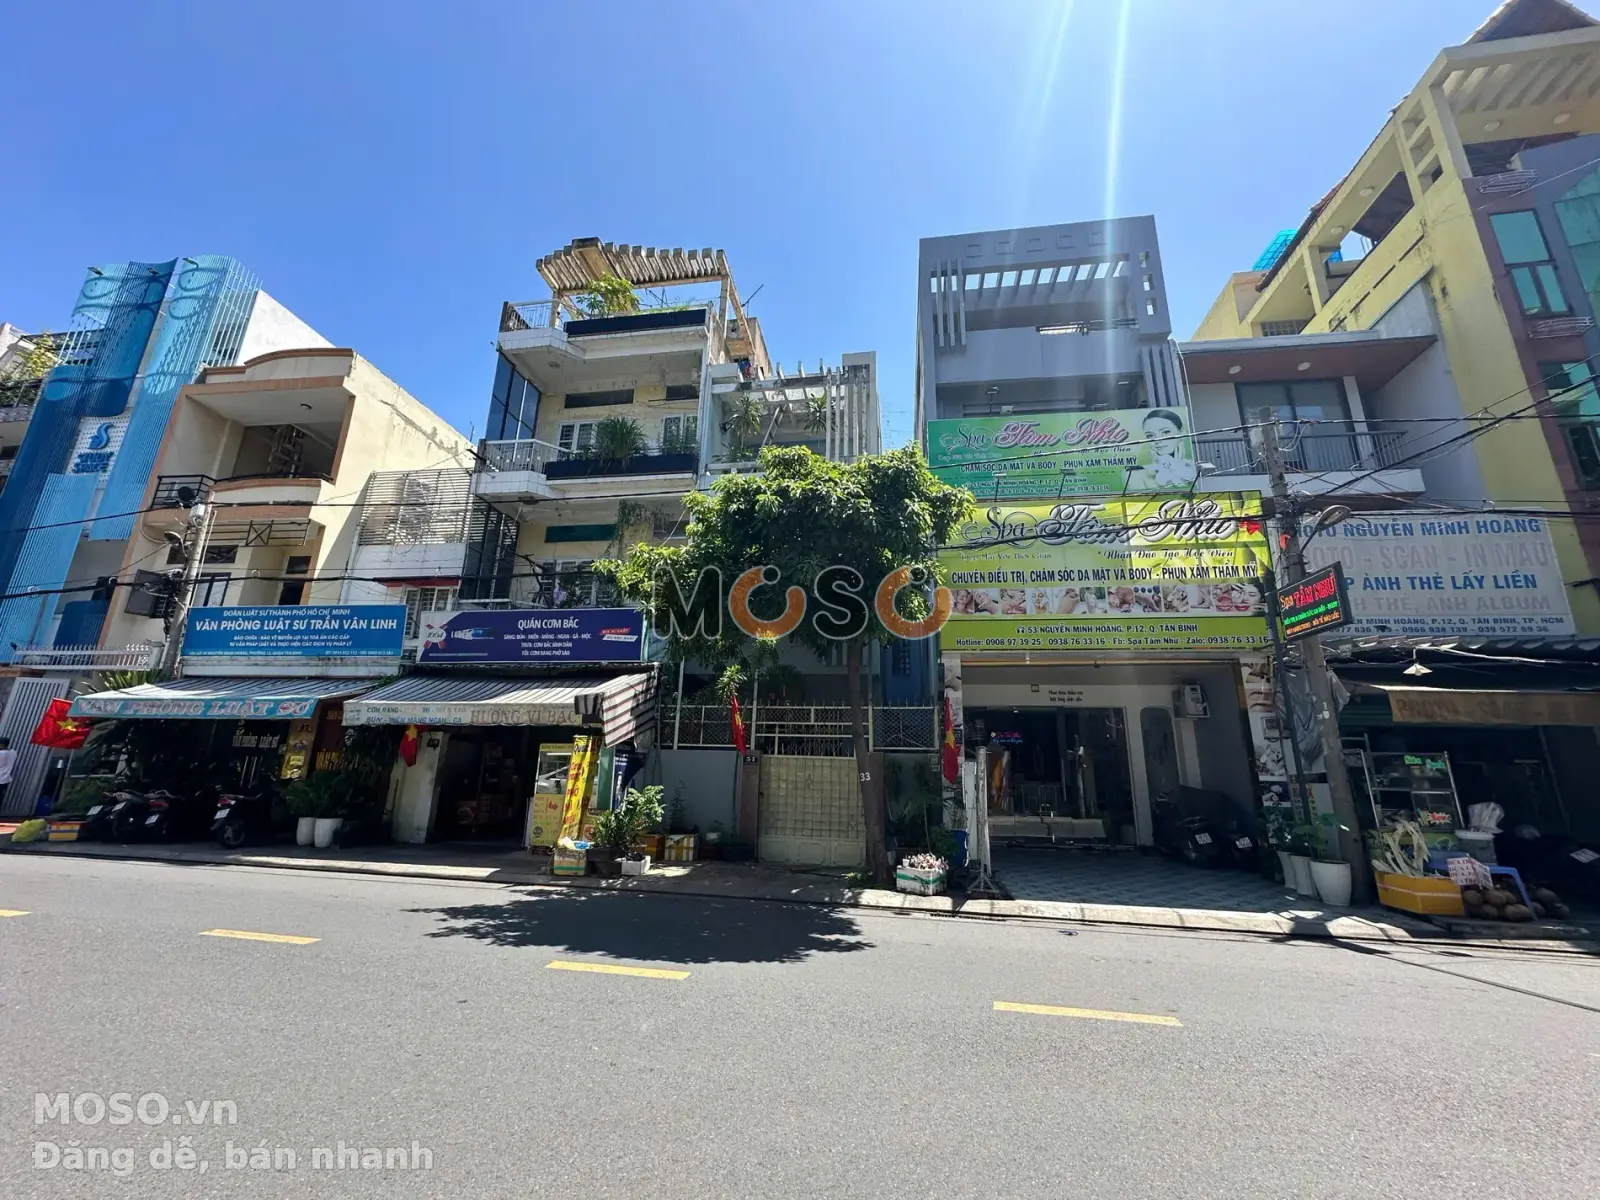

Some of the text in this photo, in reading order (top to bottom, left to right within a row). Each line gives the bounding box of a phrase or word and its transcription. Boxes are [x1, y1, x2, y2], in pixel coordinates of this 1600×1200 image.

[1038, 461, 1057, 469] BODY
[1064, 460, 1083, 468] PHUN
[1342, 516, 1542, 537] NGUYỄN MINH HOÀNG
[951, 568, 986, 584] CHUYÊN
[988, 565, 1008, 583] ĐIỀU
[1010, 571, 1028, 586] TRỊ,
[1030, 567, 1056, 582] CHĂM
[1058, 565, 1075, 582] SÓC
[1077, 569, 1090, 581] DA
[1092, 566, 1111, 584] MẶT
[1114, 565, 1127, 580] VÀ
[1129, 567, 1153, 580] BODY
[1162, 565, 1187, 579] PHUN
[1212, 559, 1239, 579] THẨM
[1243, 561, 1257, 577] MỸ
[1362, 572, 1401, 591] ẢNH
[1406, 572, 1445, 590] THẺ
[1450, 570, 1485, 590] LẤY
[1493, 569, 1538, 589] LIỀN
[1476, 596, 1551, 611] ALBUM
[332, 608, 351, 616] MINH
[195, 615, 398, 633] VĂN PHÒNG LUẬT SƯ TRẦN VÂN LINH
[518, 616, 579, 630] QUÁN CƠM BẮC
[1027, 626, 1038, 634] 53
[1039, 622, 1070, 633] NGUYỄN
[1072, 625, 1093, 633] MINH
[1095, 624, 1125, 634] HOÀNG,
[1159, 623, 1176, 633] TÂN
[1178, 623, 1198, 632] BÌNH
[956, 638, 984, 646] Hotline:
[985, 638, 1005, 646] 0908
[1007, 638, 1017, 646] 97
[1019, 638, 1029, 646] 39
[1048, 637, 1069, 645] 0938
[1071, 637, 1081, 645] 76
[1083, 637, 1093, 645] 33
[1096, 637, 1106, 645] 16
[1113, 637, 1126, 645] Fb:
[1128, 637, 1142, 646] Spa
[1144, 636, 1161, 645] Tâm
[1163, 636, 1179, 645] Như
[1186, 636, 1206, 644] Zalo:
[1208, 636, 1229, 644] 0938
[1231, 636, 1242, 644] 76
[1245, 636, 1255, 644] 33
[1258, 636, 1268, 644] 16
[860, 772, 871, 781] 33
